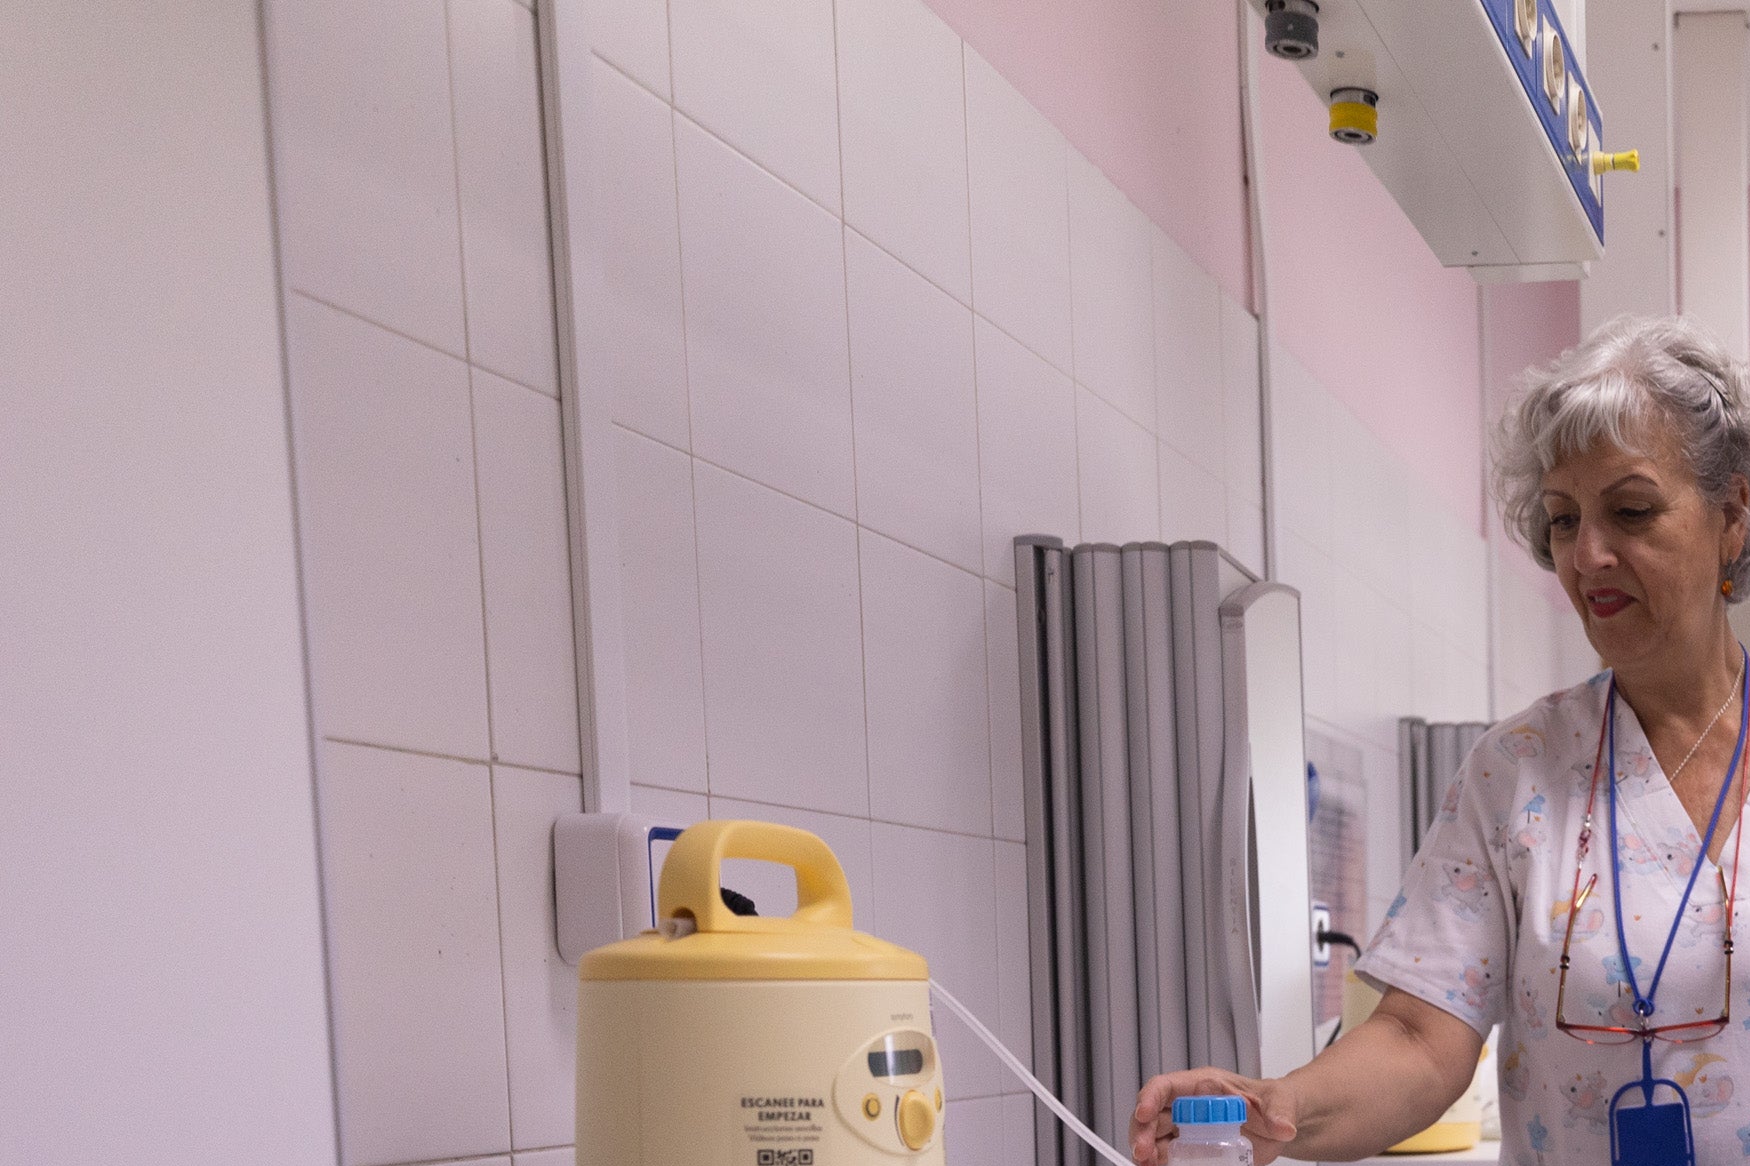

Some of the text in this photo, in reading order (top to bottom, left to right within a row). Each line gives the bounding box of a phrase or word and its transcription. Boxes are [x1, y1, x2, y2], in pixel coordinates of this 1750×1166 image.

[741, 1097, 824, 1108] ESCANEE PARA
[758, 1111, 811, 1121] EMPEZAR
